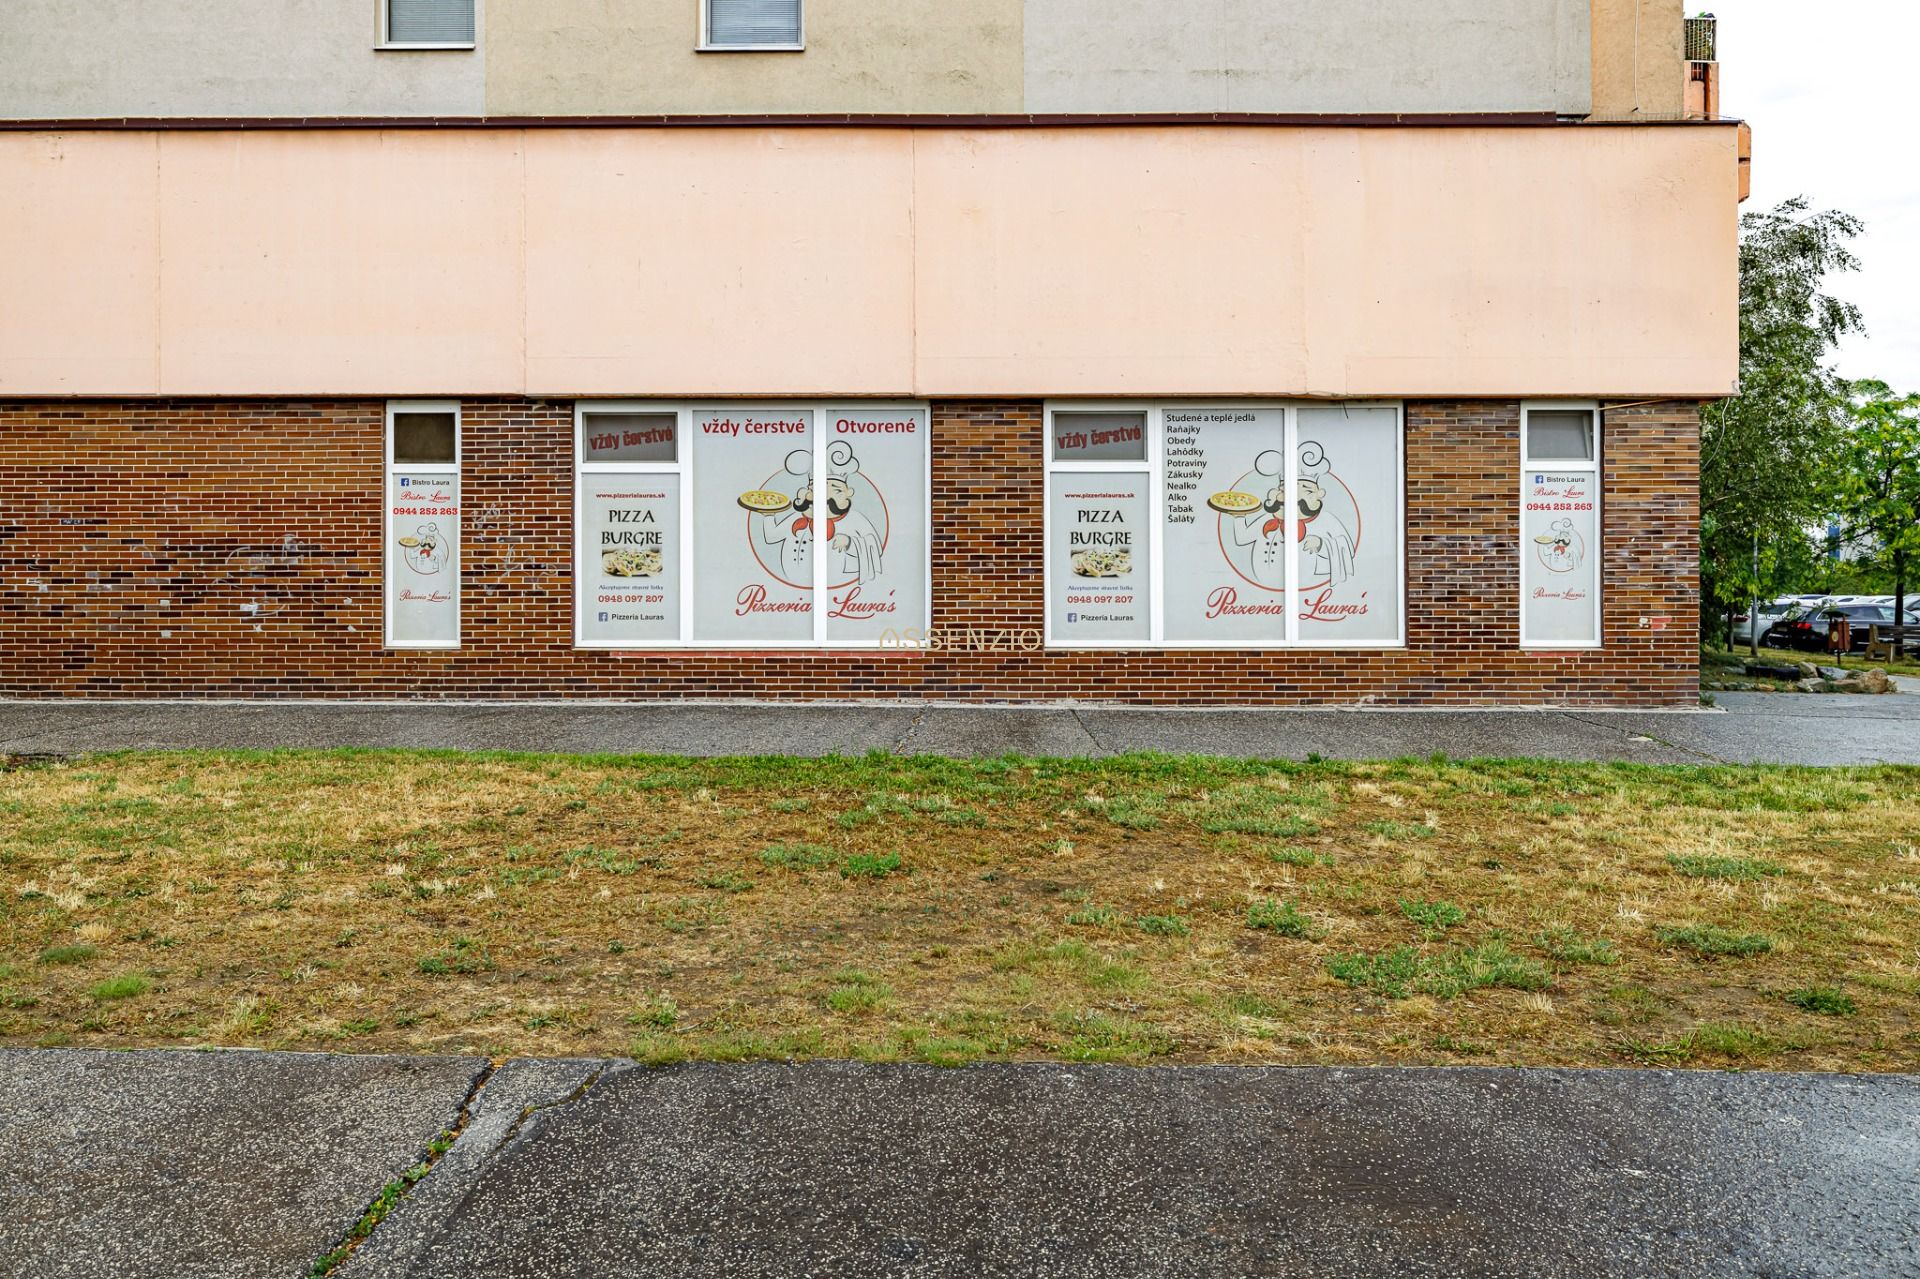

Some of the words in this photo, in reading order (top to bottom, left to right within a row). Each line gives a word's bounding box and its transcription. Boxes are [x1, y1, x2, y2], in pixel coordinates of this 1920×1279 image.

[1166, 414, 1202, 422] Studené
[1211, 413, 1233, 423] teplé
[1234, 413, 1256, 423] jedlá
[702, 419, 739, 437] vždy
[744, 418, 805, 433] čerstvé
[836, 418, 916, 433] Otvorené
[1166, 425, 1201, 434] Raňajky
[590, 433, 619, 450] vždy
[622, 426, 673, 446] čerstvé
[1057, 432, 1087, 449] vždy
[1091, 425, 1141, 446] čerstvé
[1167, 437, 1196, 446] Obedy
[1167, 448, 1204, 457] Lahôdky
[1167, 459, 1207, 468] Potraviny
[1167, 470, 1203, 480] Zákusky
[1167, 482, 1197, 490] Nealko
[1533, 486, 1559, 496] Bistro
[1562, 485, 1584, 498] Laura
[400, 490, 426, 501] Bistro
[428, 490, 451, 503] Laura
[1168, 493, 1187, 501] Alko
[393, 507, 417, 515] 0944
[420, 507, 438, 515] 252
[440, 507, 458, 515] 263
[1527, 503, 1551, 511] 0944
[1553, 503, 1572, 511] 252
[1574, 503, 1592, 511] 263
[608, 510, 655, 523] PIZZA
[1078, 510, 1124, 523] PIZZA
[601, 531, 663, 546] BURGRE
[1070, 532, 1132, 547] BURGRE
[598, 595, 622, 603] 0948
[624, 595, 643, 603] 097
[645, 595, 664, 603] 207
[736, 584, 812, 616] Pizzeria
[1206, 586, 1283, 619] Pizzeria
